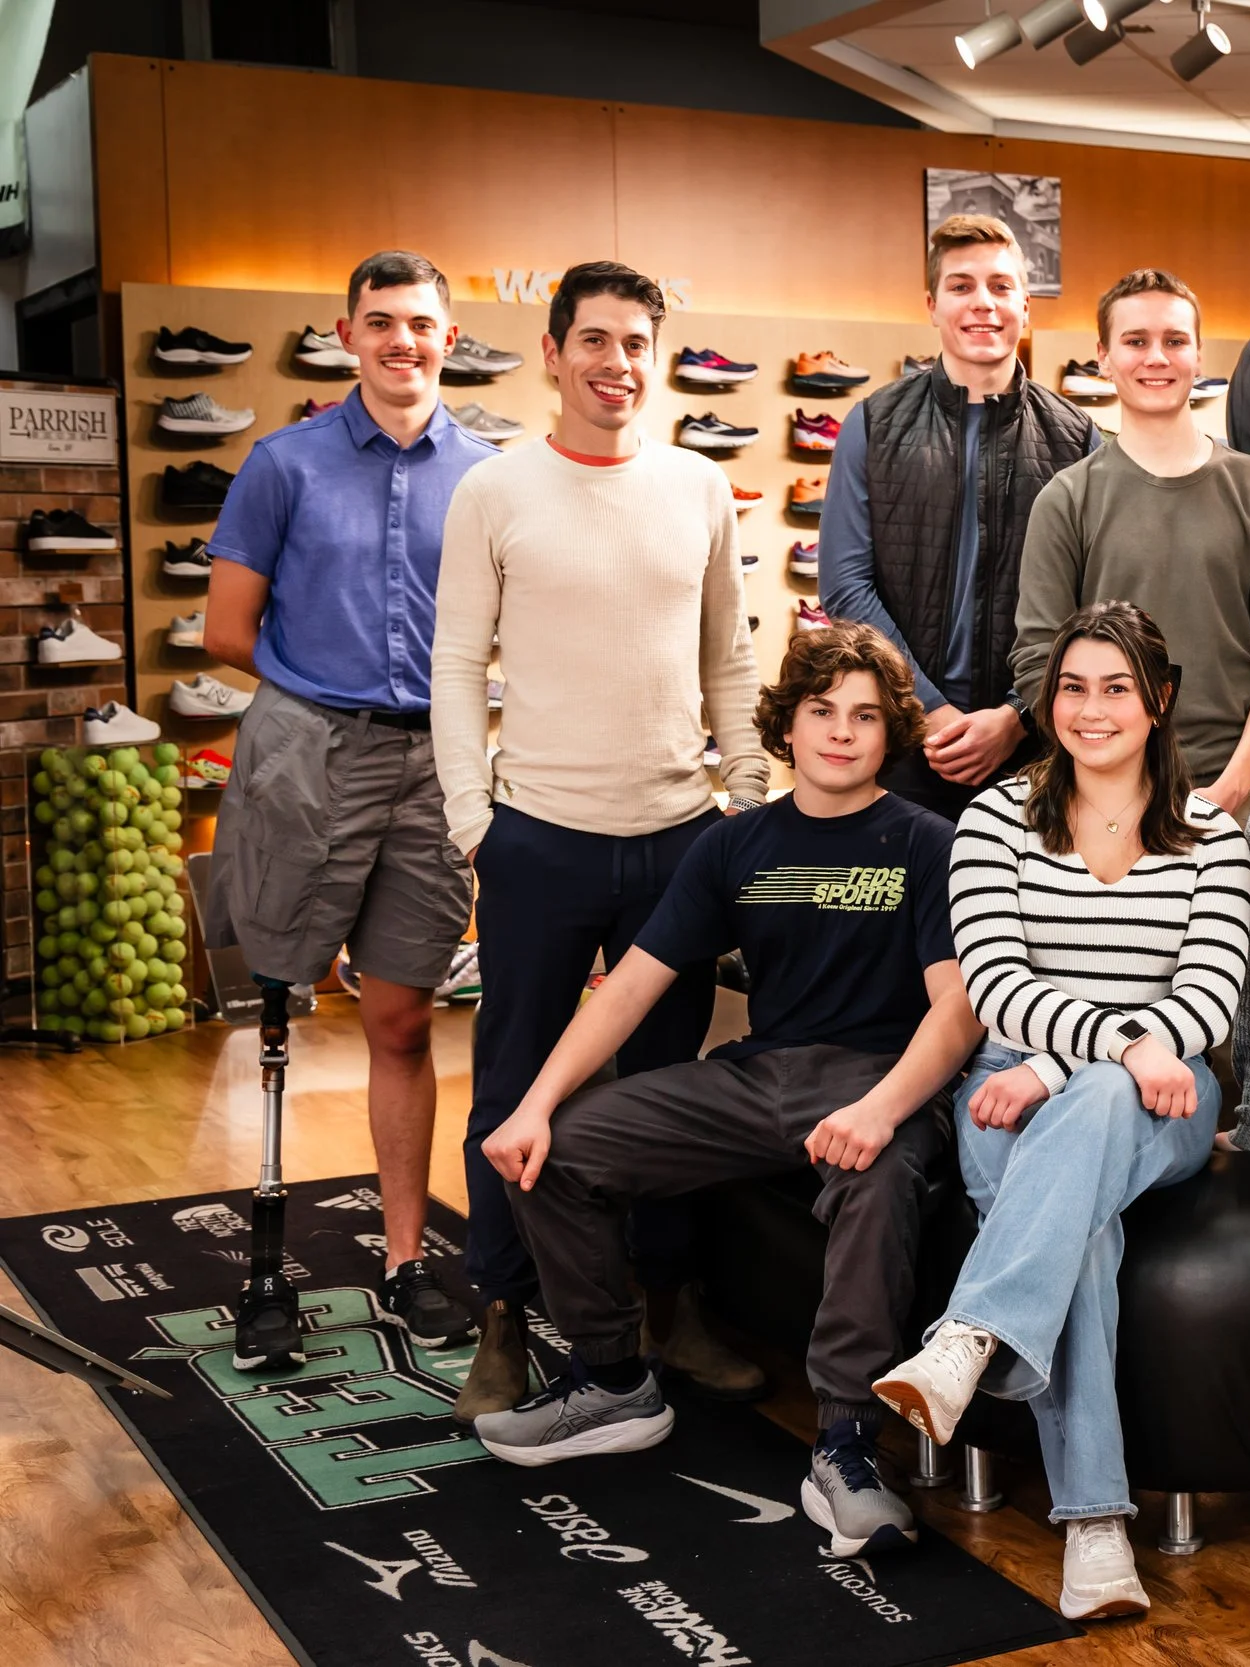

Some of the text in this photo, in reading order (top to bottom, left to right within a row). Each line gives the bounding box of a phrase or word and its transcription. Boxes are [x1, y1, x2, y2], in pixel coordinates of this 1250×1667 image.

[9, 406, 107, 433] PARRISH
[847, 866, 906, 887] TEDS
[811, 883, 905, 906] SPORTS
[86, 1217, 134, 1248] SOLE
[617, 1586, 659, 1612] ONE
[638, 1580, 682, 1604] ONE
[817, 1562, 912, 1624] saucony
